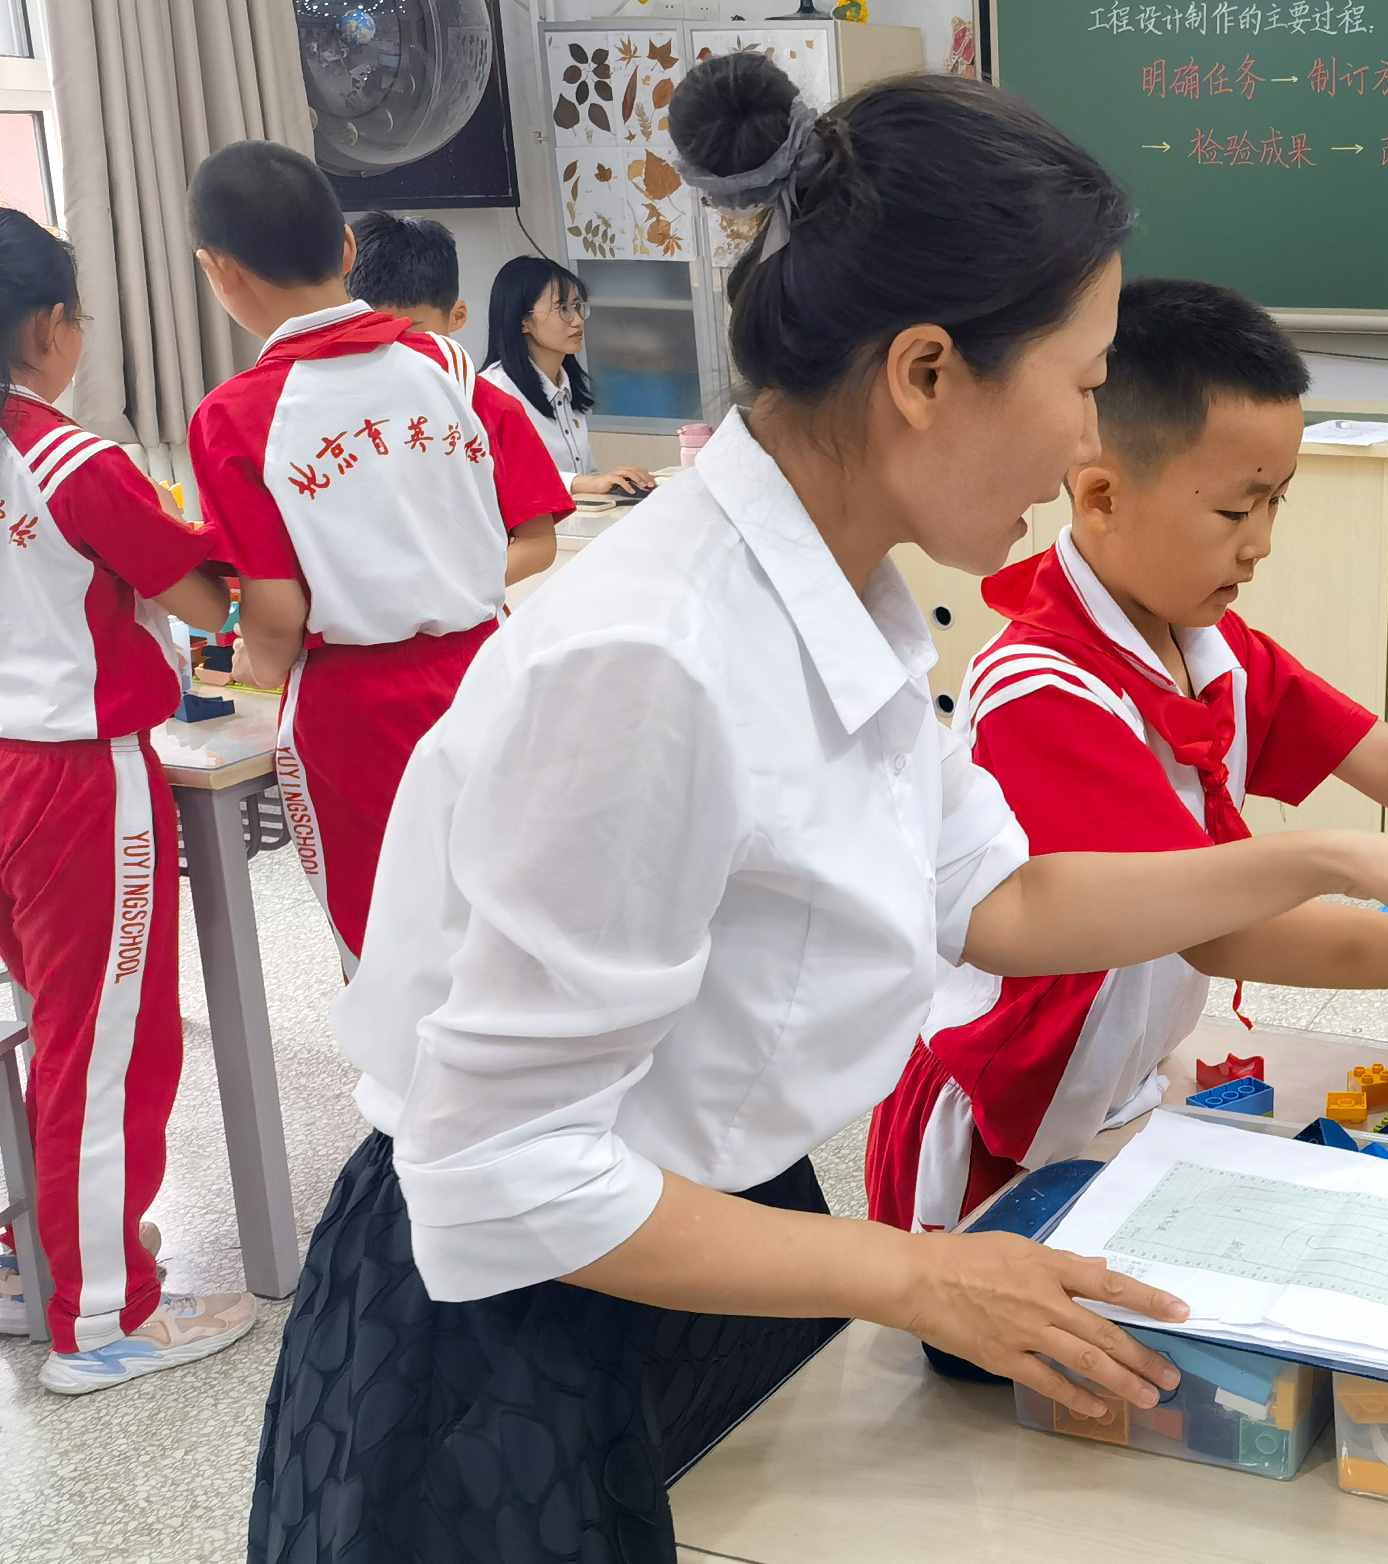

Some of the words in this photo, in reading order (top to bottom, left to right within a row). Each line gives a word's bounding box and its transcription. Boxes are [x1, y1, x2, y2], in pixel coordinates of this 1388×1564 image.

[1140, 54, 1266, 100] 明确任务
[1187, 127, 1318, 169] 检验成果
[288, 416, 486, 500] 北京育英学校
